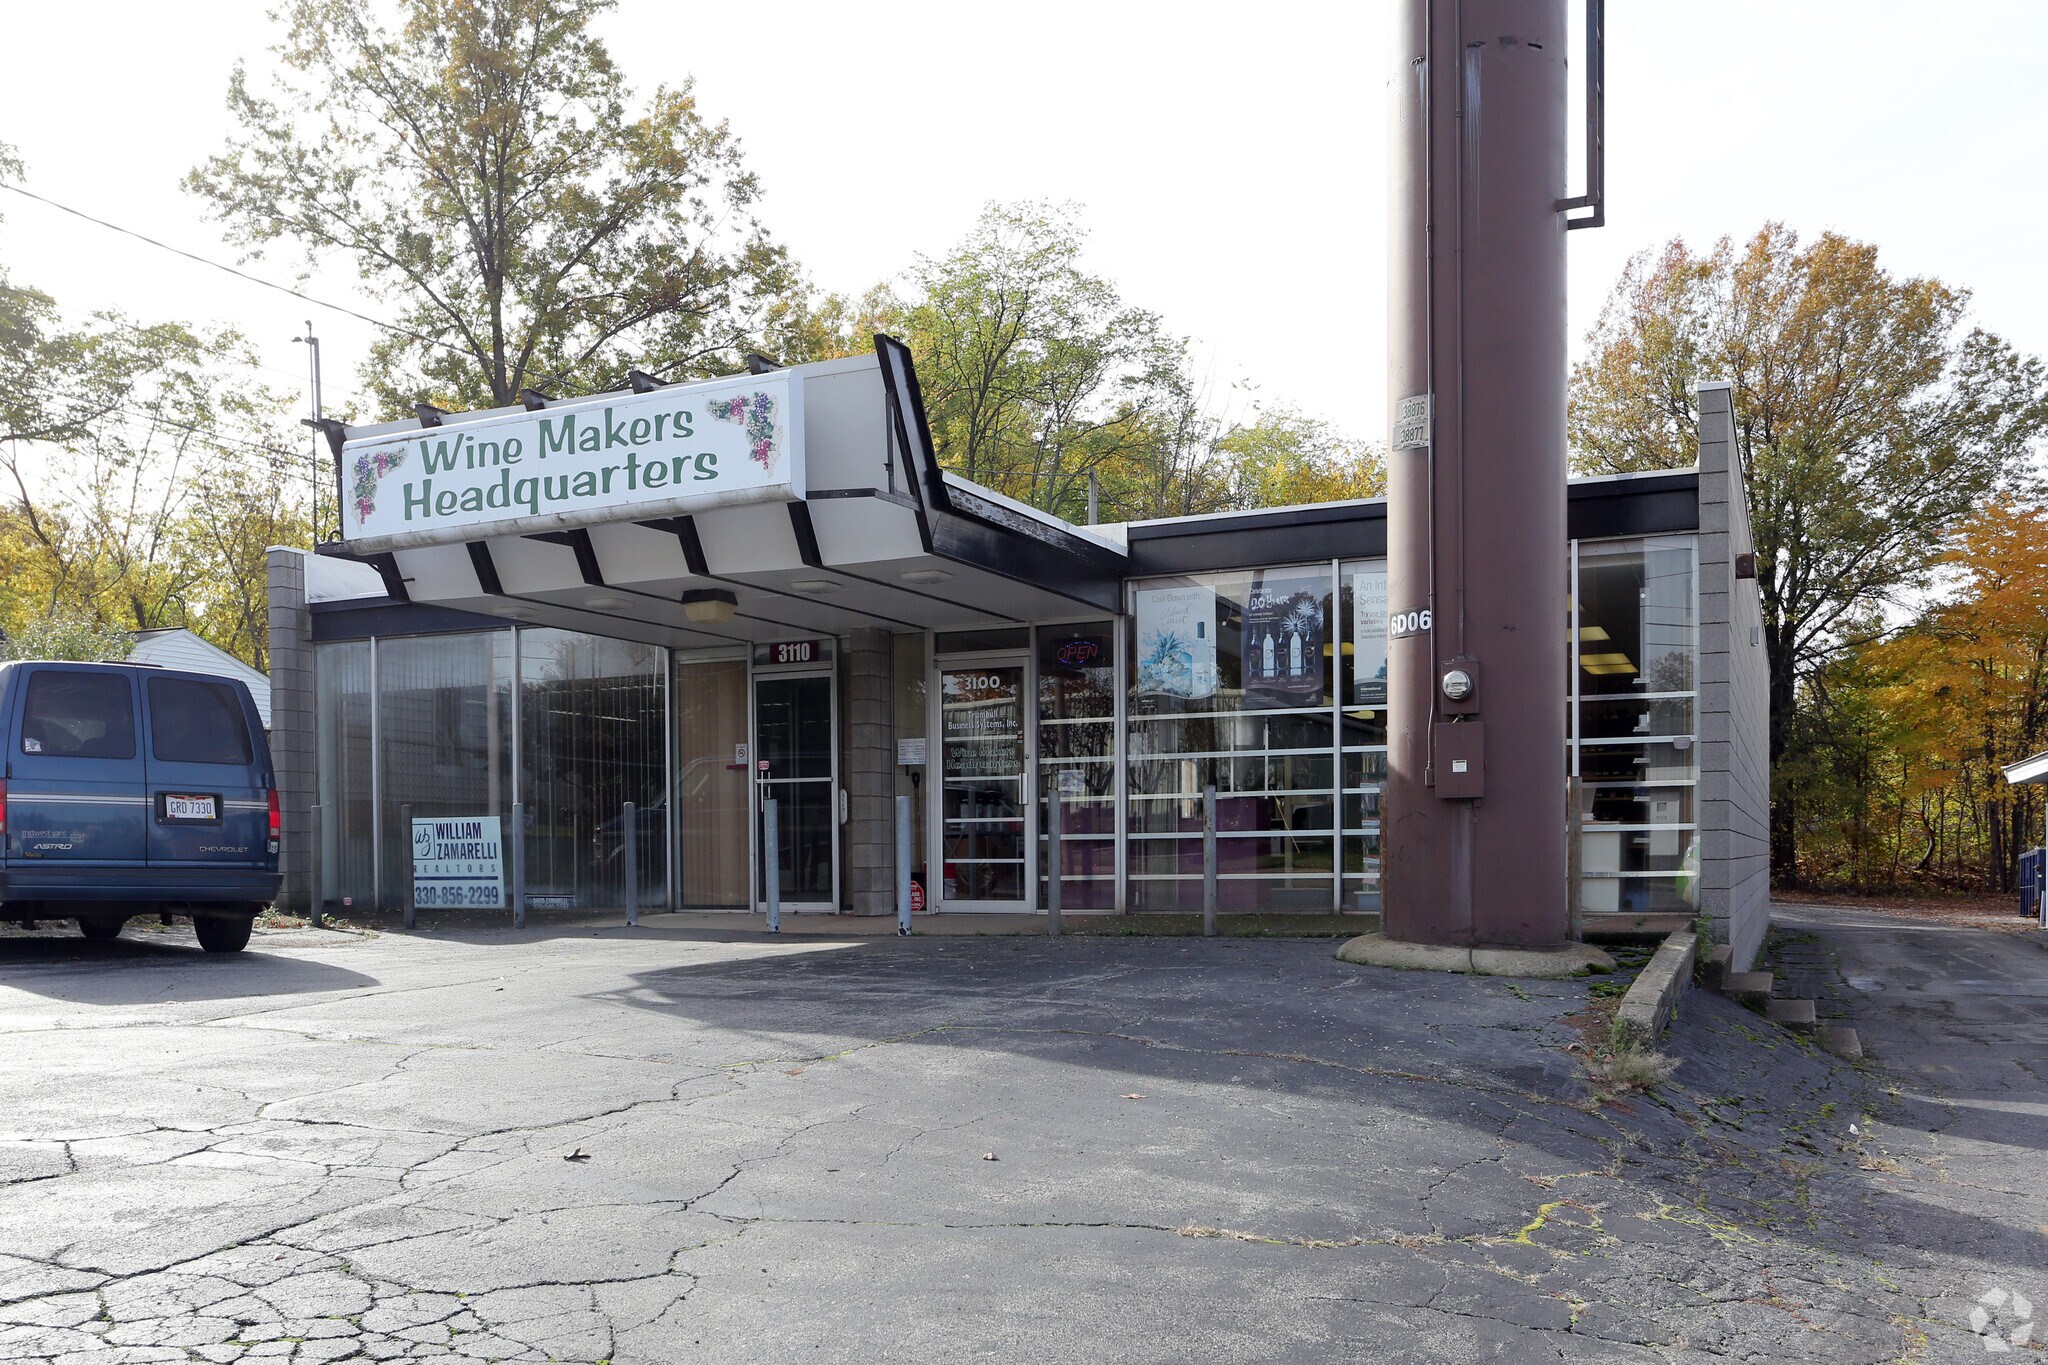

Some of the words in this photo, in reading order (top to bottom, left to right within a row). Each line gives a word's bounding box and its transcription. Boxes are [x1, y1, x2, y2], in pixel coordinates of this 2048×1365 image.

[420, 433, 523, 475] Wine
[539, 408, 694, 459] Makers
[1400, 426, 1423, 443] 38877
[403, 452, 719, 520] Headquarters
[1359, 580, 1372, 591] An
[1375, 579, 1387, 590] Int
[1152, 594, 1166, 603] Cool
[1167, 594, 1186, 602] Down
[1187, 592, 1200, 601] with
[1251, 597, 1266, 611] 20
[1360, 594, 1388, 605] Sensa
[1391, 610, 1432, 635] 6D06
[778, 643, 811, 663] 3110
[1057, 645, 1098, 661] OPEN
[965, 675, 1001, 690] 3100
[968, 710, 998, 718] Trumbull
[948, 721, 975, 730] Business
[976, 720, 1005, 730] Systems,
[1006, 719, 1018, 727] Inc.
[951, 748, 977, 757] Wine
[946, 759, 1021, 770] Headquarters
[170, 801, 187, 813] GRD
[190, 802, 212, 814] 7330
[435, 822, 482, 840] WILLIAM
[437, 842, 498, 860] ZAMARELLI
[413, 864, 496, 873] REALTORS
[415, 886, 499, 905] 330-856-2299
